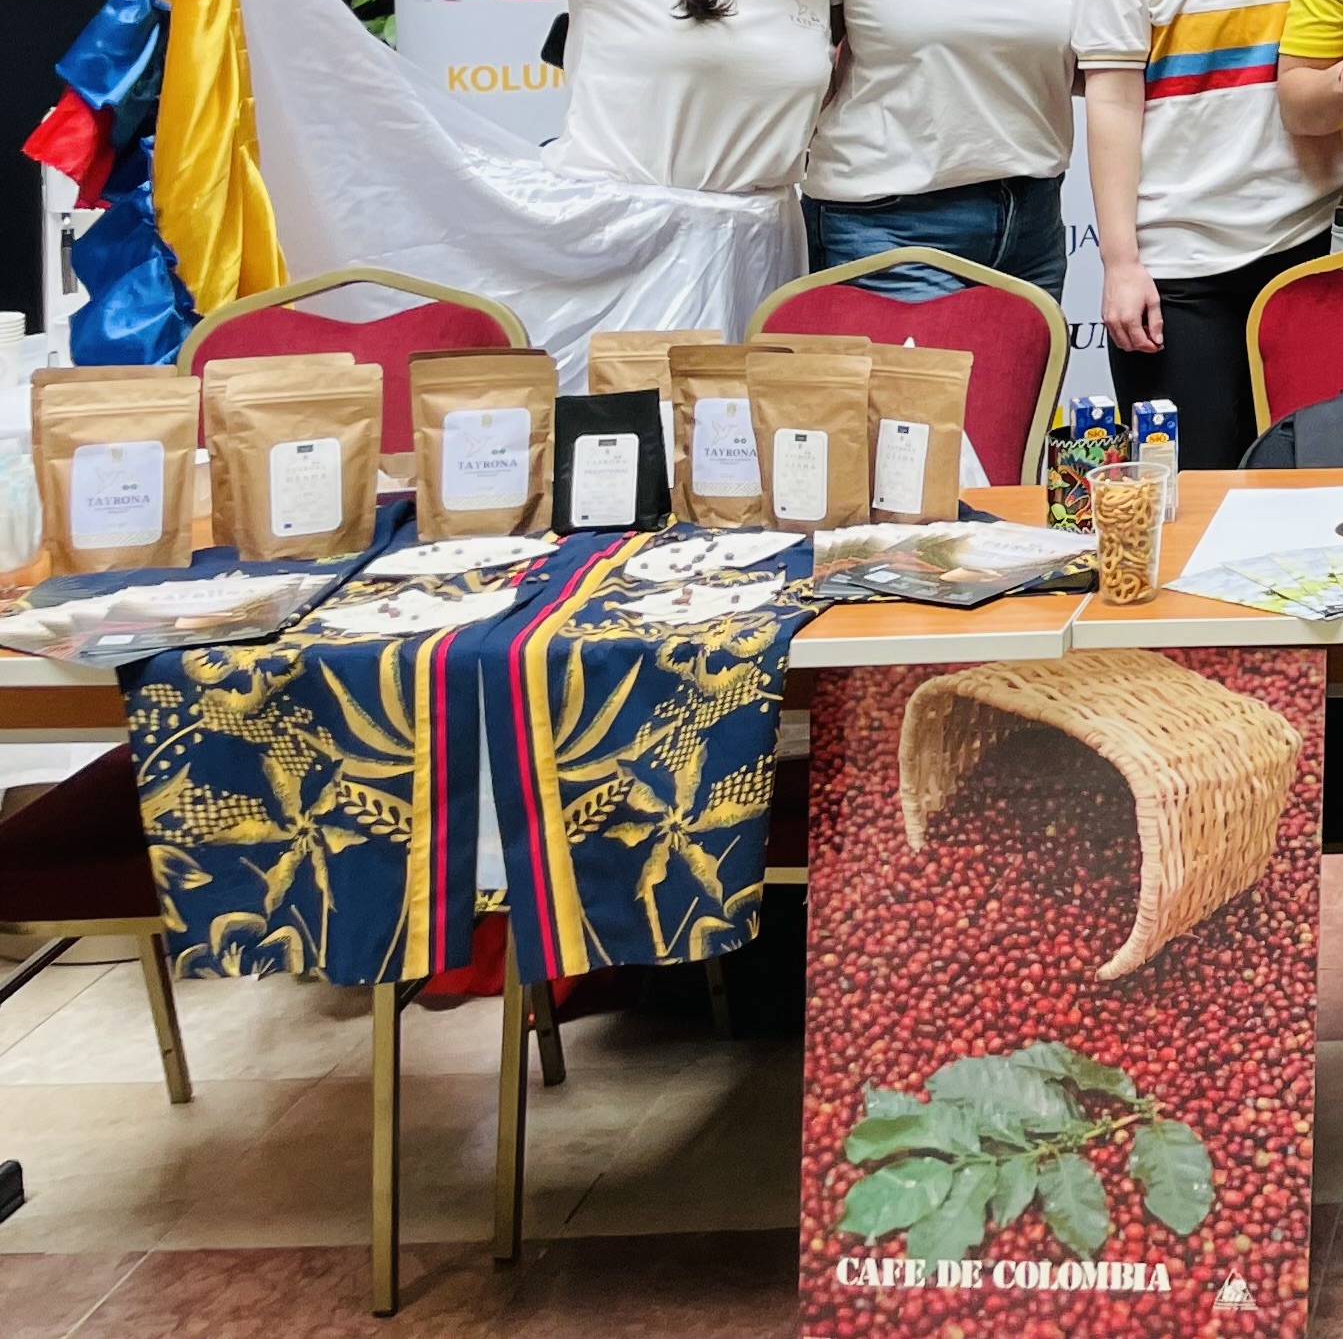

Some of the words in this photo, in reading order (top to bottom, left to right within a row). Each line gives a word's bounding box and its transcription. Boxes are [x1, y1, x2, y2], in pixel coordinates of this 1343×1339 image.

[458, 459, 518, 470] TAYRONA
[836, 1257, 926, 1288] CAFE
[936, 1259, 983, 1289] DE
[992, 1261, 1172, 1291] COLOMBIA
